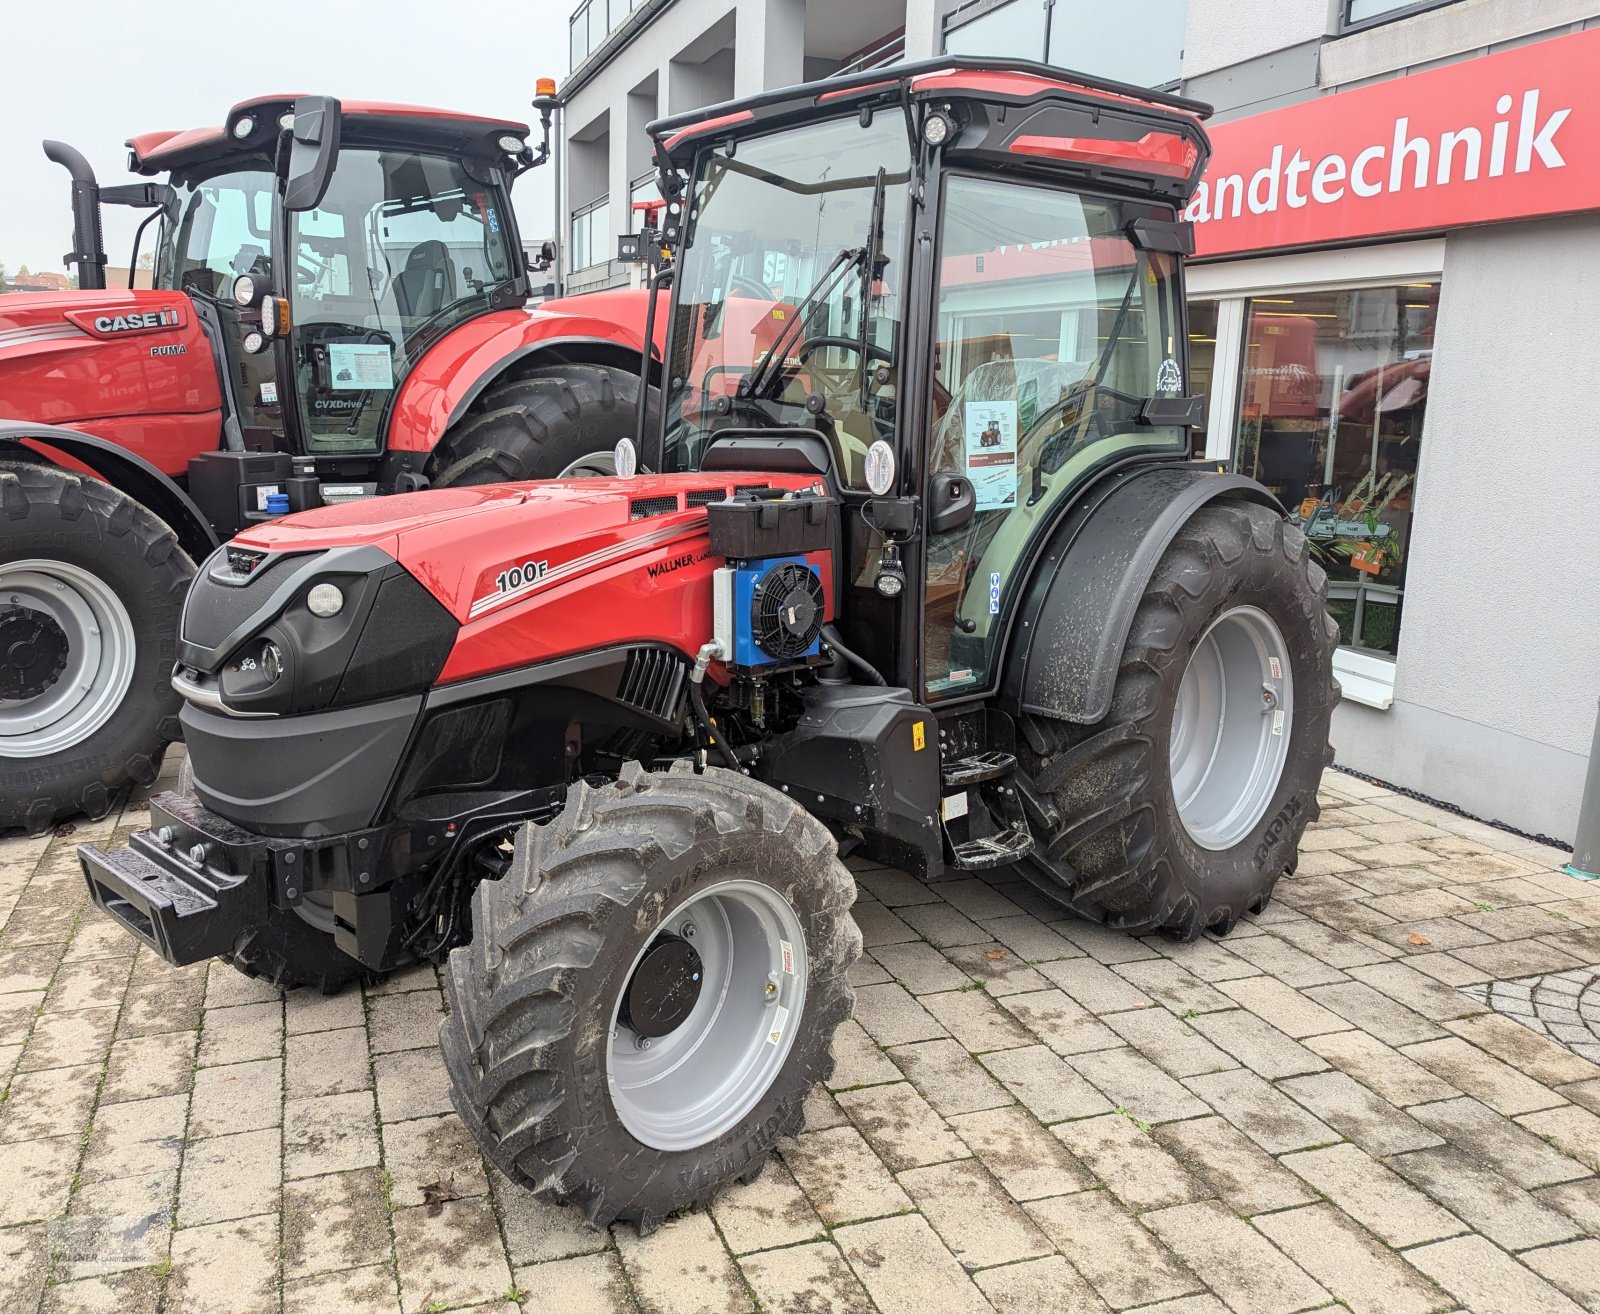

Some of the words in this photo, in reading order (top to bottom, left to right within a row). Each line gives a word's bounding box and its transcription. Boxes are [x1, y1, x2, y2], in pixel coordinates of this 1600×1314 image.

[1181, 88, 1572, 225] andtechnik
[94, 311, 158, 333] CASE
[150, 344, 187, 358] PUMA
[315, 400, 363, 409] CVXDrive
[496, 561, 548, 593] 100F
[1253, 796, 1302, 870] Kleber
